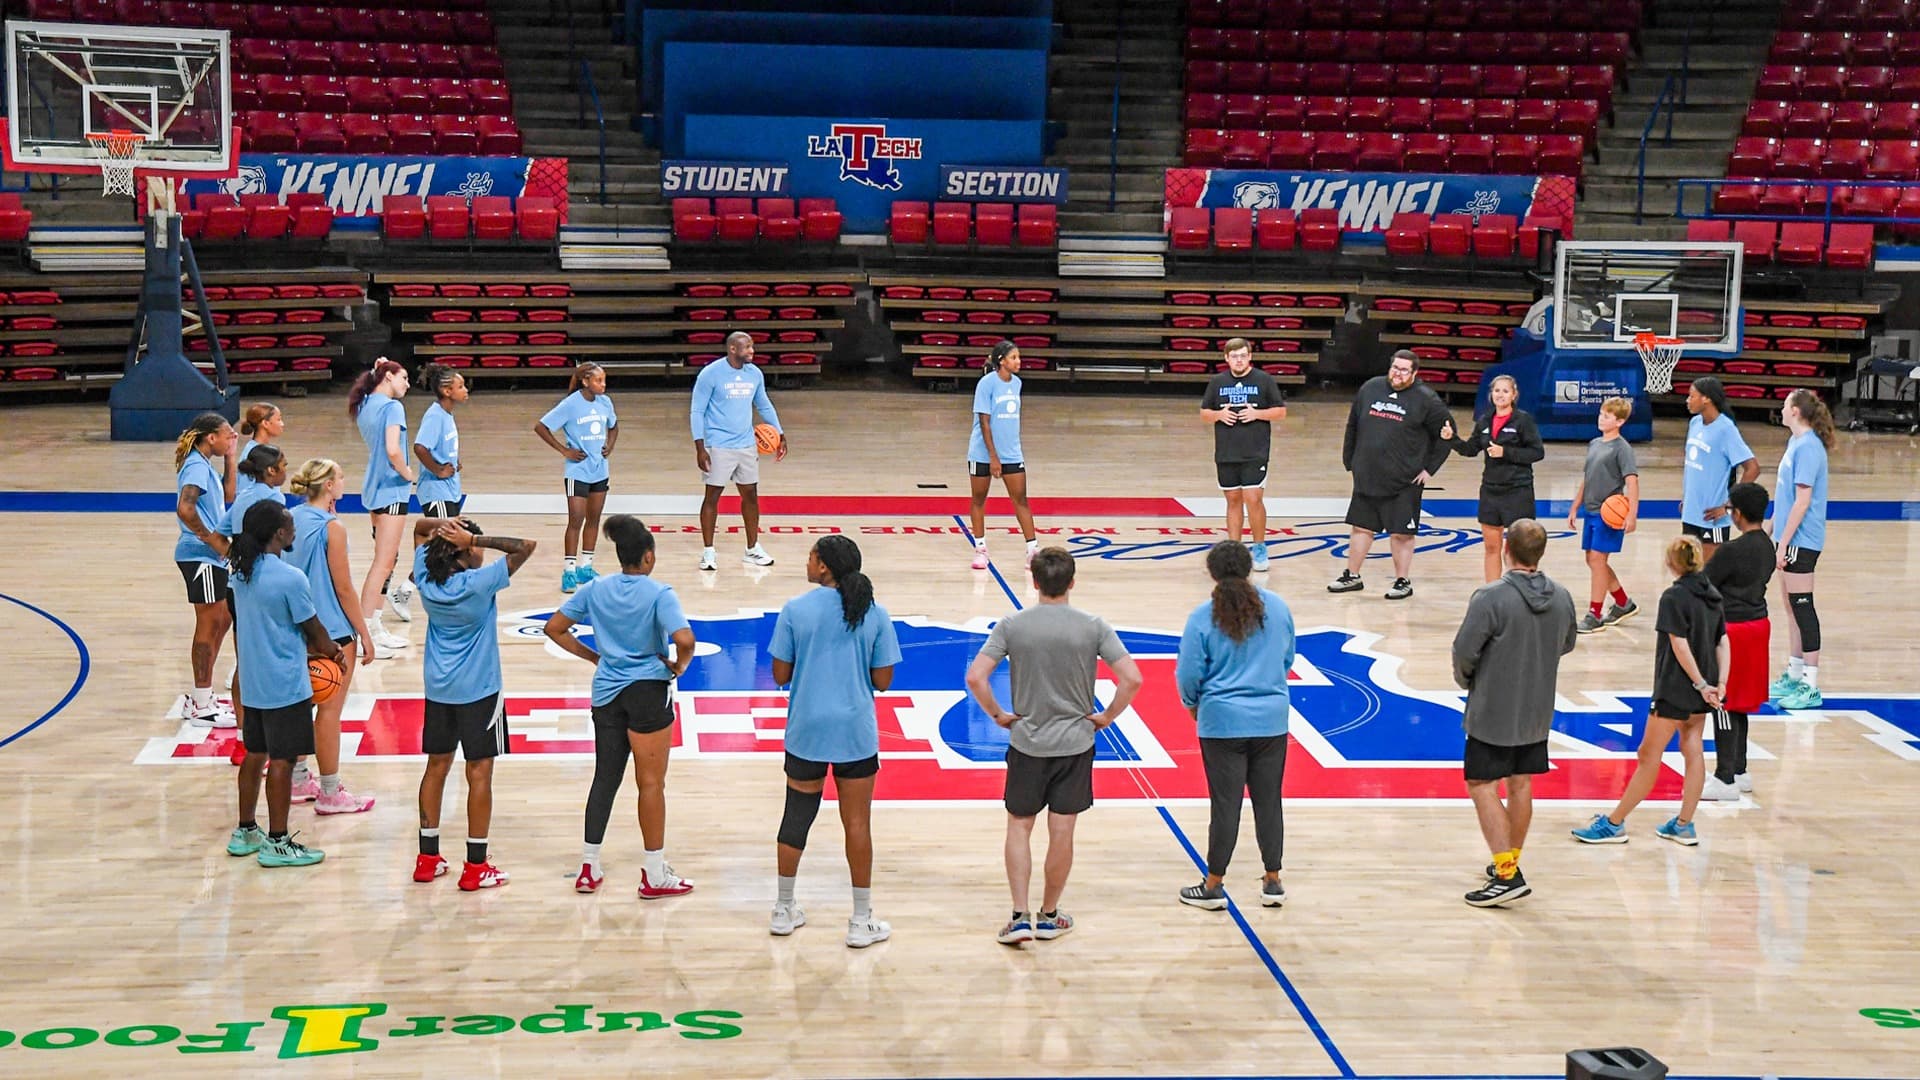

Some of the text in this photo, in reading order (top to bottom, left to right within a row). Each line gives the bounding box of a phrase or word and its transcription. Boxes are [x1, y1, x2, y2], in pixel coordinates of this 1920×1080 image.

[663, 167, 788, 192] STUDENT
[946, 171, 1060, 197] SECTION
[1219, 386, 1258, 396] LOUISIANA
[1229, 395, 1248, 404] TECH
[388, 1004, 744, 1040] Super
[0, 1021, 266, 1054] Foo
